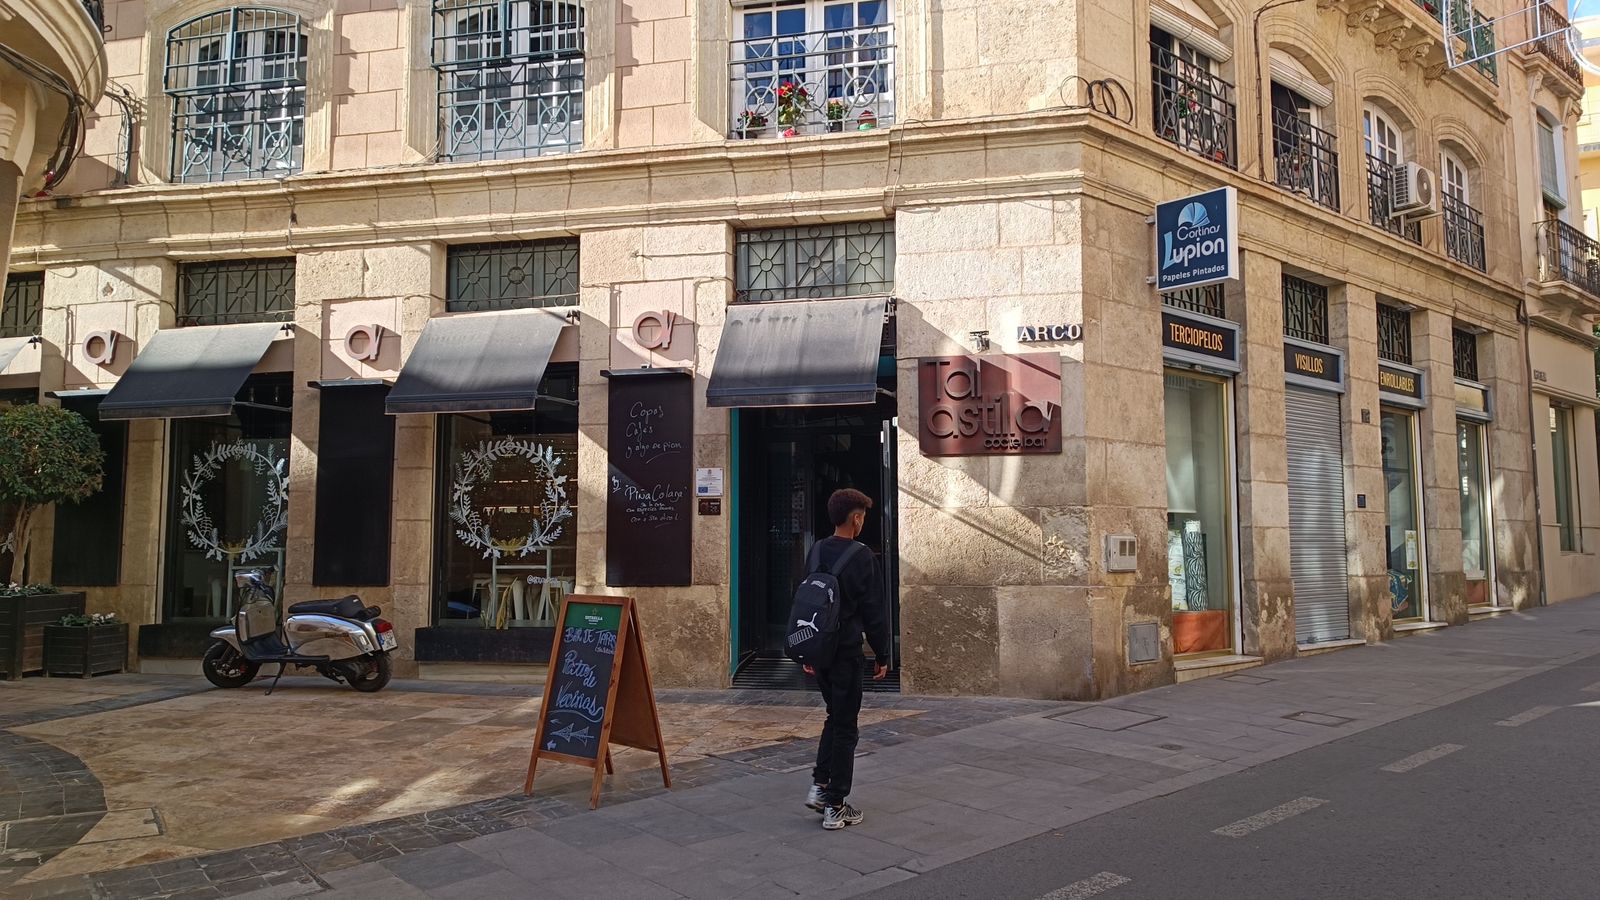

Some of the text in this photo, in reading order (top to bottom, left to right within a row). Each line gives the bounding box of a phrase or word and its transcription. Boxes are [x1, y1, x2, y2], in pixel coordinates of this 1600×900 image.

[1177, 225, 1220, 240] Cortinas
[1163, 231, 1225, 270] Lupion
[1163, 265, 1225, 282] Papeles Pintados
[1018, 324, 1081, 342] ARCO
[1169, 323, 1223, 352] TERCIOPELOS
[1295, 353, 1324, 374] VISILLOS
[926, 357, 982, 400] Tal
[1380, 371, 1415, 393] ENROLLABLES
[630, 401, 664, 425] Copas
[1025, 437, 1048, 448] bar
[583, 628, 596, 644] DE
[788, 626, 814, 648] PUMA
